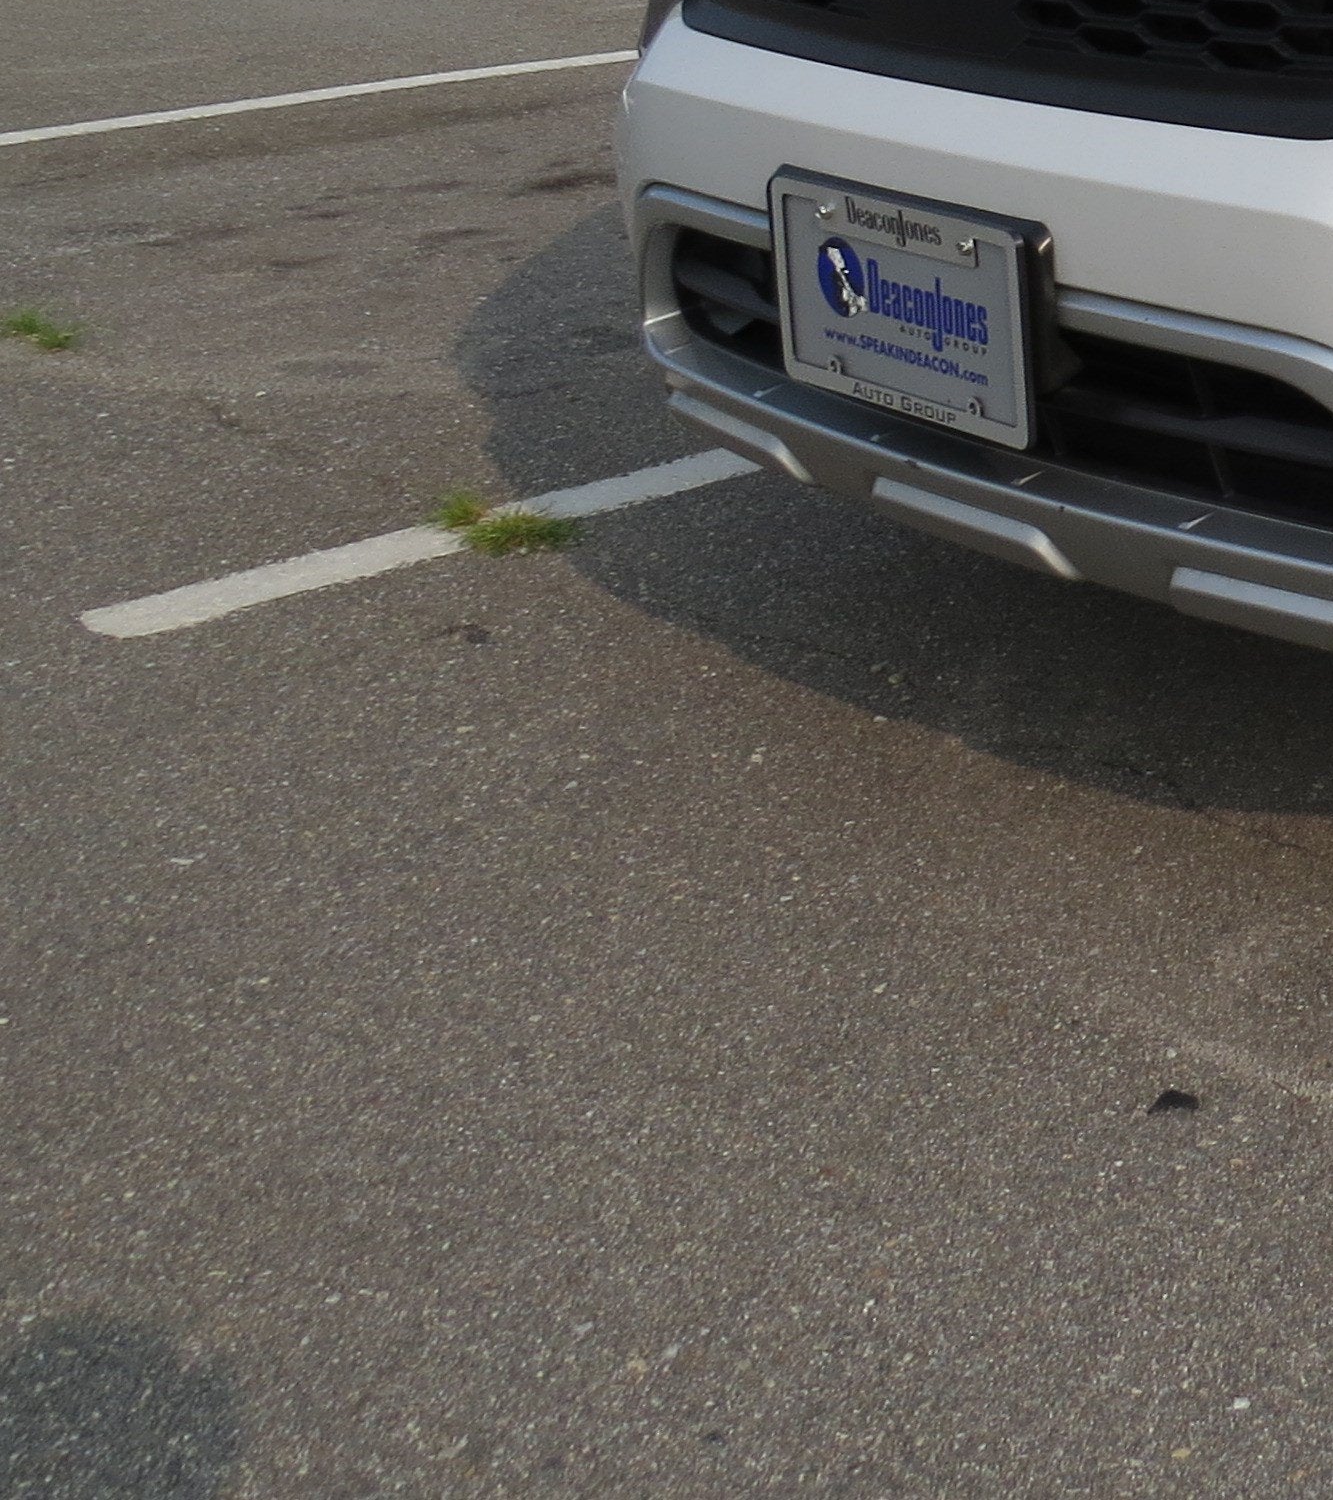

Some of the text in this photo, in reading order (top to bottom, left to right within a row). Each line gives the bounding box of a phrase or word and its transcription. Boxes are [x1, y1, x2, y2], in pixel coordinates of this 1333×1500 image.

[899, 324, 988, 356] AUTO GROUP
[852, 381, 957, 424] AUTO GROUP
